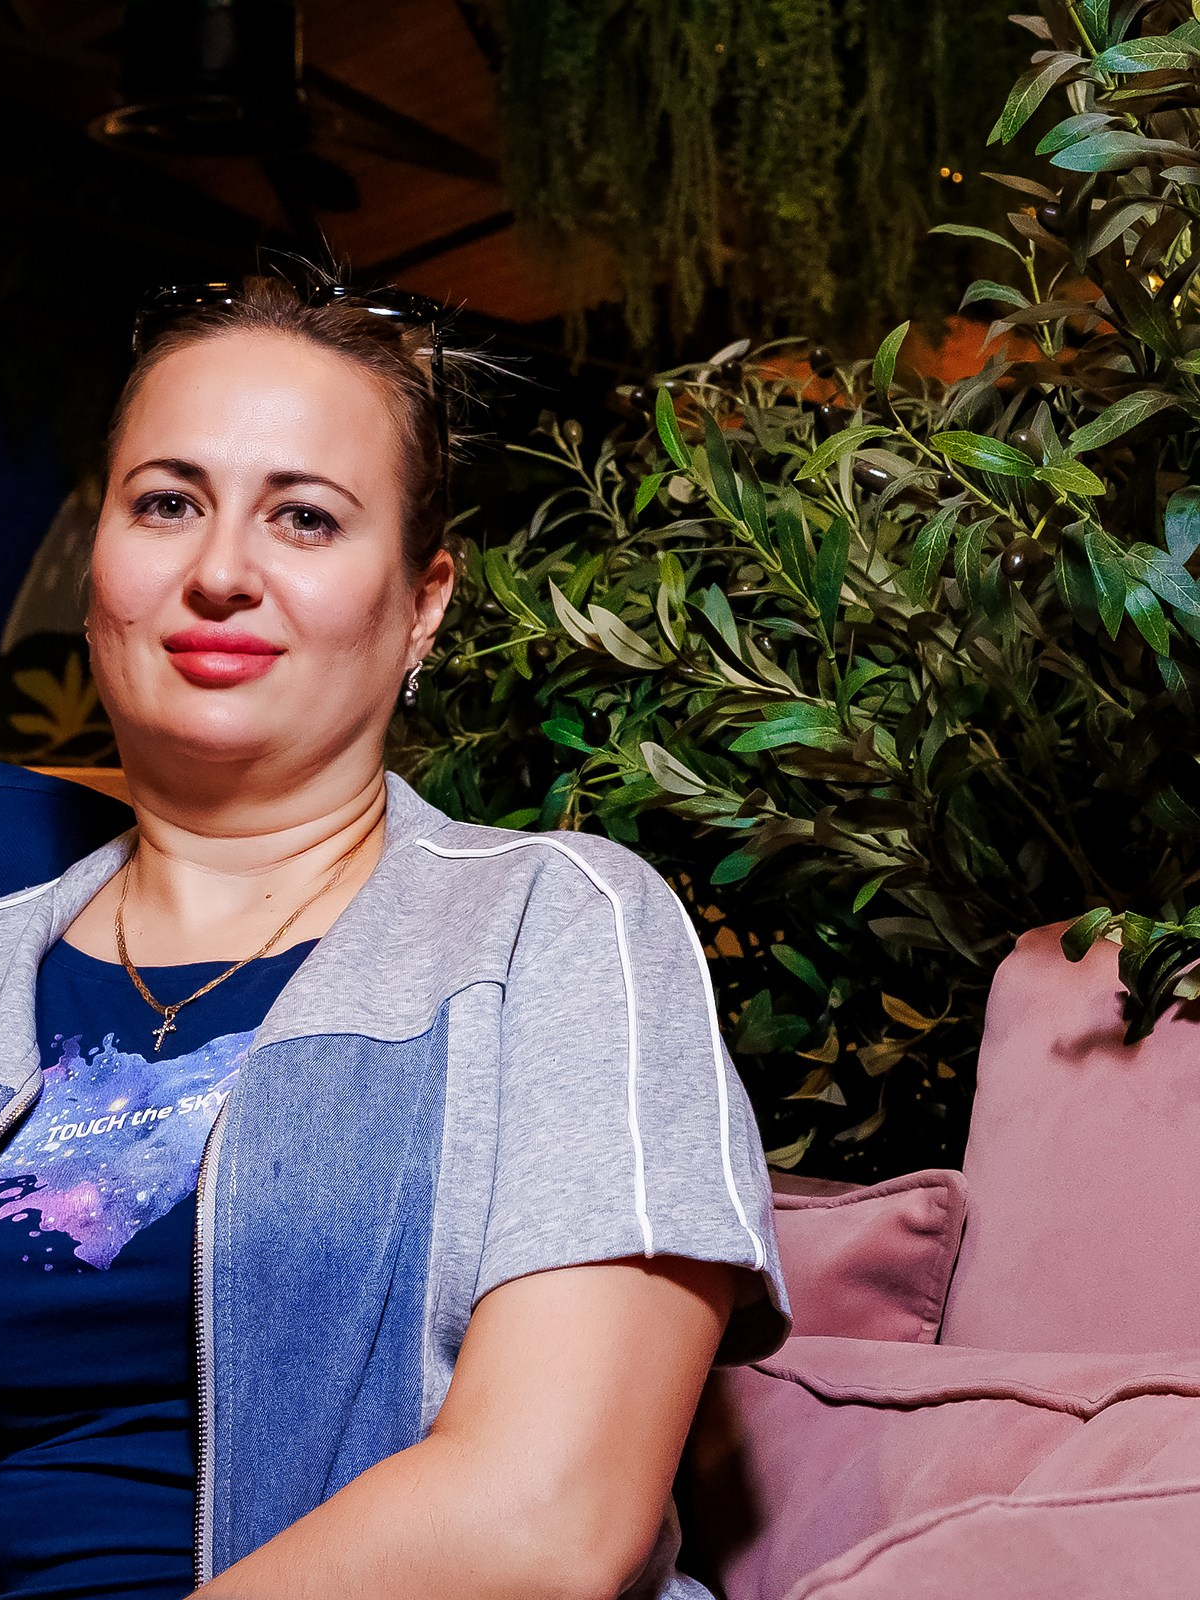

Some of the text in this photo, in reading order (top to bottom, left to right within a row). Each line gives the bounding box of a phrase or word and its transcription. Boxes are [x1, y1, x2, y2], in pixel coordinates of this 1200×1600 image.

[47, 1089, 231, 1143] TOUCH the SKY
